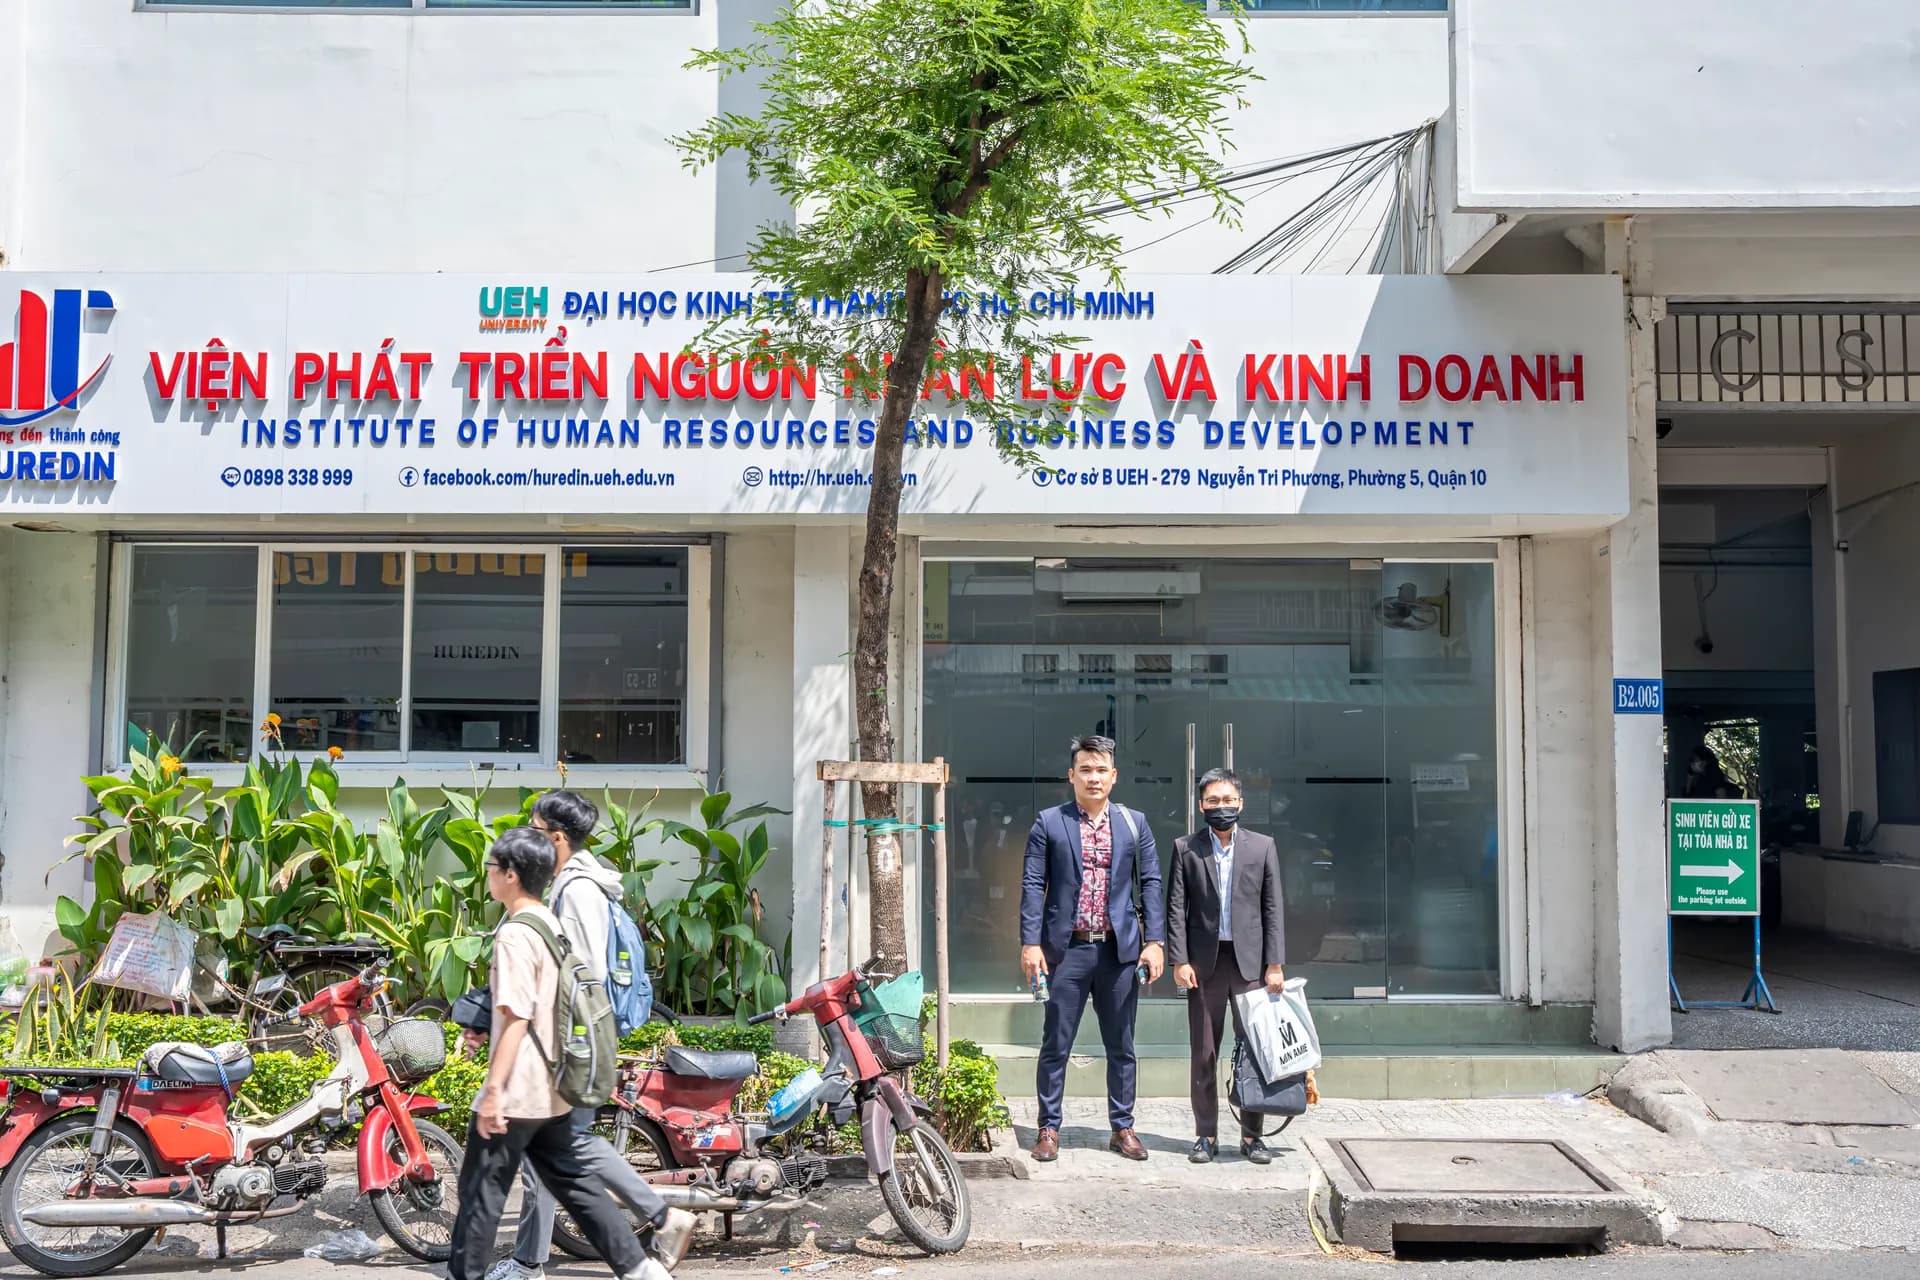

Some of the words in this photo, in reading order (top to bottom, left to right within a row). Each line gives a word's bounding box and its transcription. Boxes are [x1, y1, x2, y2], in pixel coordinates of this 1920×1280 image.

[480, 286, 548, 316] UEH
[563, 291, 608, 321] ĐẠI
[618, 291, 677, 321] HỌC
[687, 291, 752, 316] KINH
[1085, 291, 1154, 316] MINH
[480, 319, 547, 330] UNIVERSITY
[150, 337, 268, 411] VIỆN
[295, 337, 431, 400] PHÁT
[460, 325, 608, 400] TRIỂN
[1153, 339, 1217, 401] VÀ
[1245, 354, 1370, 401] KINH
[1399, 354, 1584, 401] DOANH
[242, 418, 435, 445] INSTITUTE
[458, 418, 499, 444] OF
[517, 418, 640, 445] HUMAN
[664, 418, 875, 446] RESOURCES
[903, 418, 973, 445] AND
[1205, 420, 1474, 446] DEVELOPMENT
[243, 468, 284, 486] 0898
[288, 468, 319, 486] 338
[322, 468, 353, 486] 999
[423, 467, 675, 487] facebook.com/huredin.ueh.edu.vn
[1056, 468, 1077, 486] Cơ
[1080, 467, 1099, 486] sở
[1102, 468, 1113, 486] B
[1116, 468, 1149, 486] UEH
[1160, 468, 1191, 486] 279
[1198, 466, 1255, 489] Nguyễn
[1258, 468, 1278, 486] Tri
[1282, 469, 1344, 489] Phương,
[1348, 469, 1406, 489] Phường
[1410, 469, 1424, 488] 5,
[1428, 469, 1467, 491] Quận
[1470, 469, 1487, 486] 10
[432, 644, 519, 660] HUREDIN
[1618, 685, 1659, 708] B2.005
[1675, 812, 1696, 828] SINH
[1698, 810, 1719, 828] VIÊN
[1739, 814, 1751, 829] XE
[1678, 833, 1692, 851] TẠI
[1736, 835, 1748, 850] B1
[1678, 895, 1688, 903] the
[1689, 895, 1713, 905] parking
[1696, 887, 1716, 895] Please
[152, 1080, 193, 1089] DAELIM
